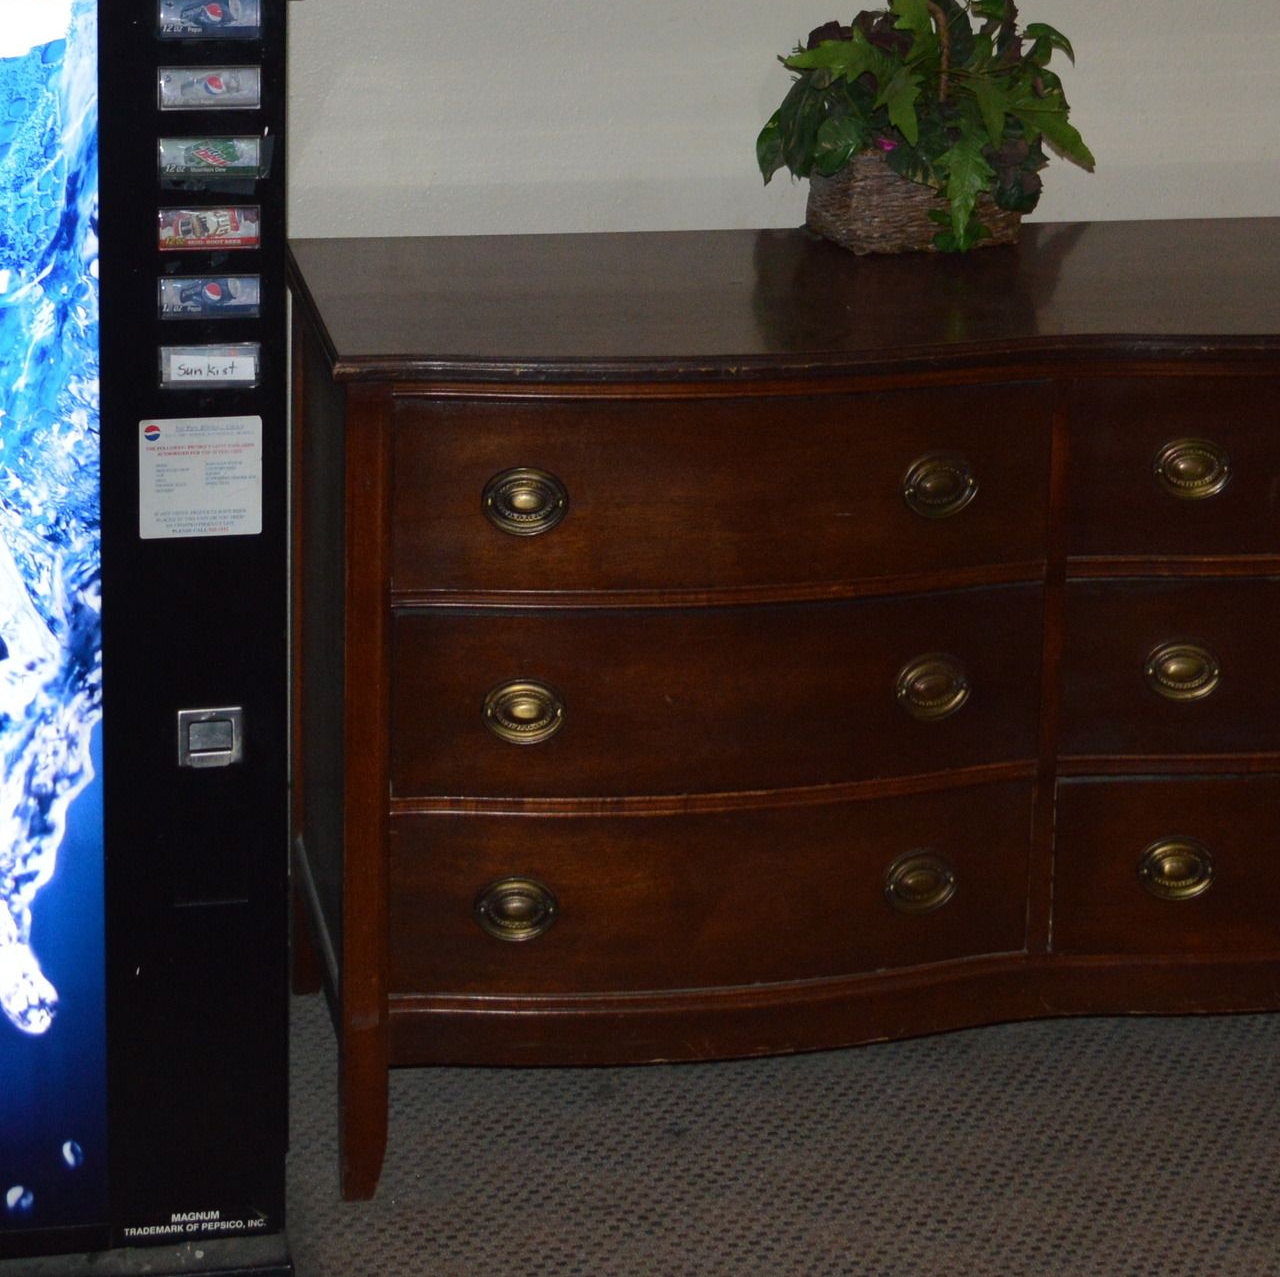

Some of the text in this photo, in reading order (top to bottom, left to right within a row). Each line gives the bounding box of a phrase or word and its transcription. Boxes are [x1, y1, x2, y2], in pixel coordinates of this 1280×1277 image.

[162, 24, 172, 32] 12
[166, 164, 175, 172] 12
[171, 1210, 220, 1223] MAGNUM
[124, 1219, 266, 1236] TRADEMARK OF PEPSICO, INC.
